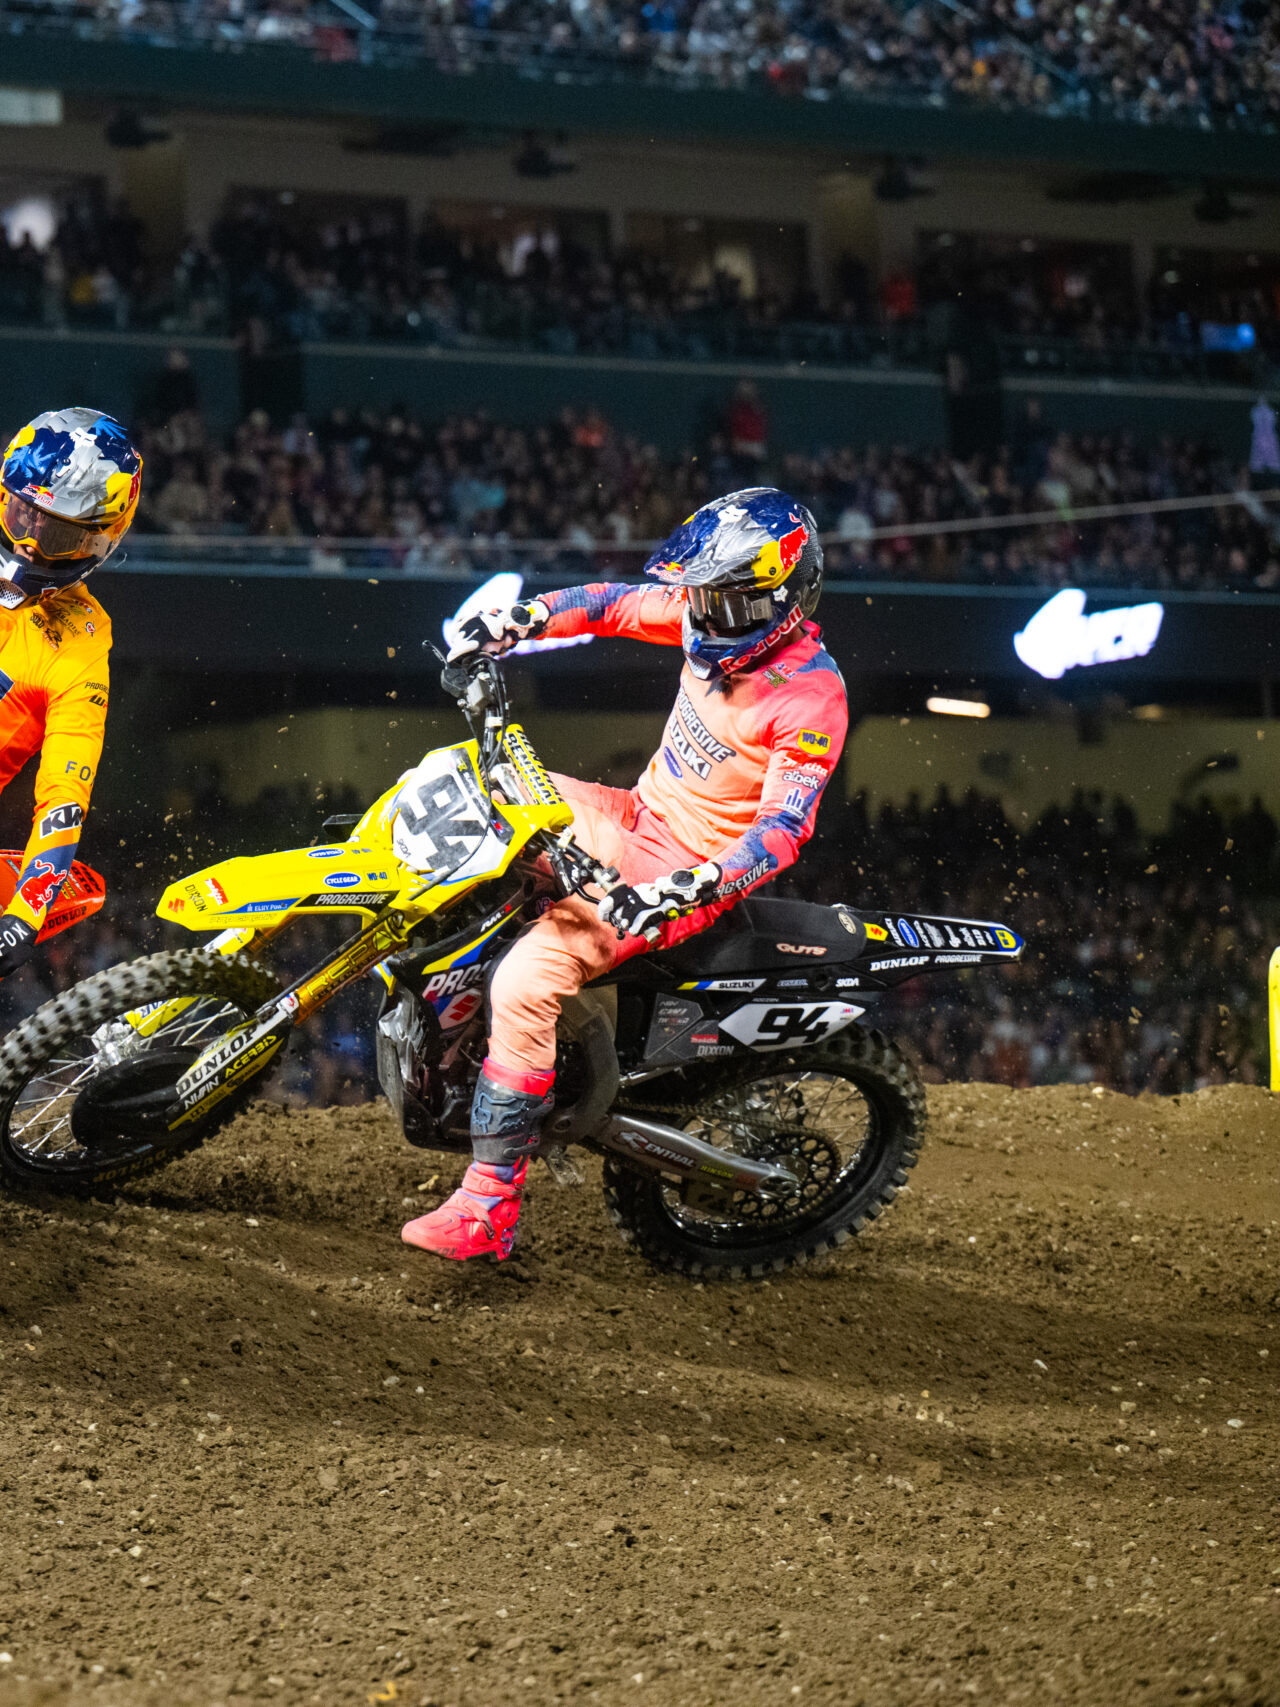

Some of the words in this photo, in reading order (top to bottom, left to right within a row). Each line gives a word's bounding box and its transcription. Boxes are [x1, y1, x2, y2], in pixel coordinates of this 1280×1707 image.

[669, 710, 713, 781] UZUKI
[802, 732, 828, 748] WD-40
[65, 760, 94, 788] FO
[40, 802, 84, 839] KTM
[315, 893, 389, 905] PROGRESSIVE
[47, 906, 87, 929] DUNLOP
[870, 956, 930, 972] DUNLOP
[718, 981, 755, 989] SUZUKI
[835, 977, 860, 988] SKDA
[749, 1006, 830, 1046] 94
[176, 1026, 257, 1095] DUNLOP
